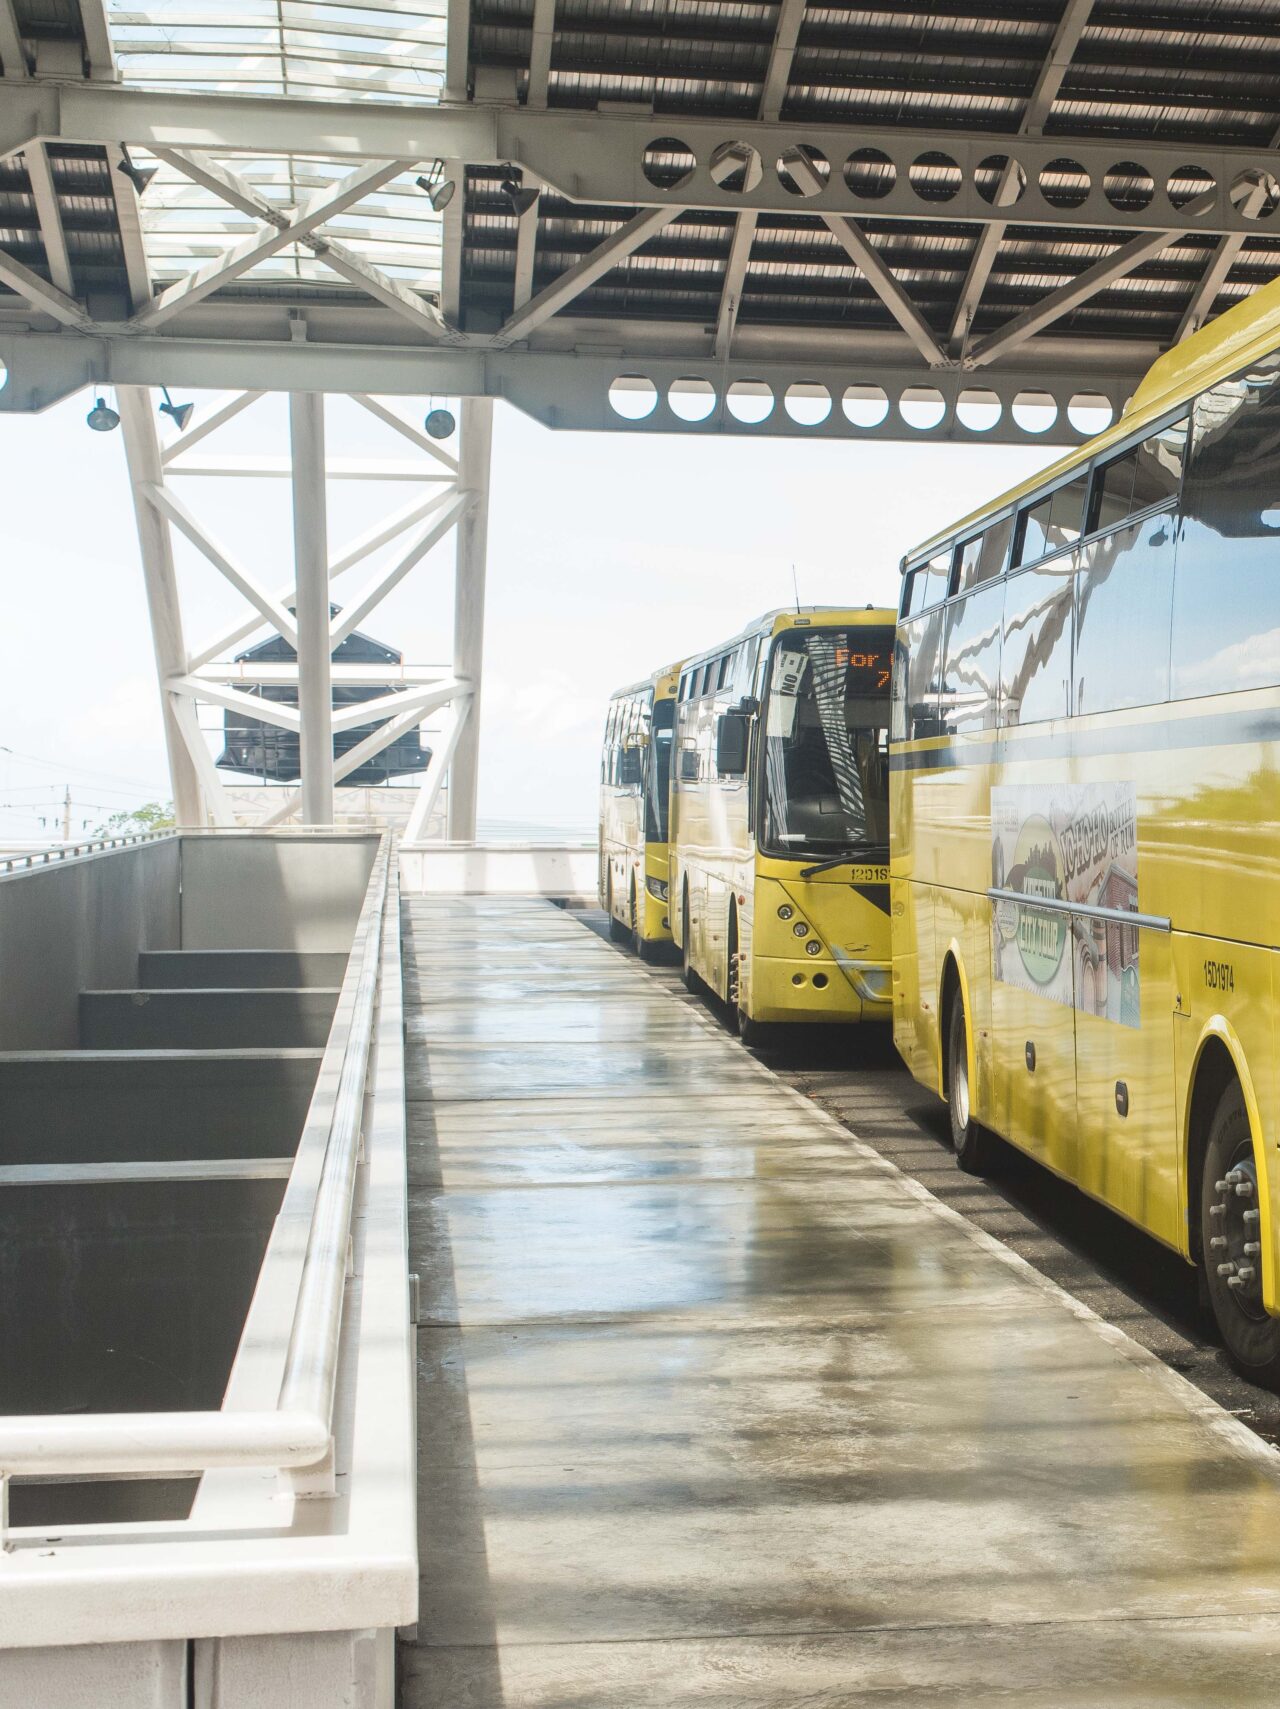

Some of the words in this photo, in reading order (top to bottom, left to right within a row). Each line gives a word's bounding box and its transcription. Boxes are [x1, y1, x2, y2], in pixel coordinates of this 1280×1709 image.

[835, 647, 879, 667] For
[1109, 798, 1134, 834] BOTTLE
[1110, 833, 1119, 860] OF
[1120, 822, 1135, 856] RUM
[1020, 914, 1038, 954] CITY
[1037, 917, 1059, 961] TOUR
[1203, 960, 1235, 993] 15D1974
